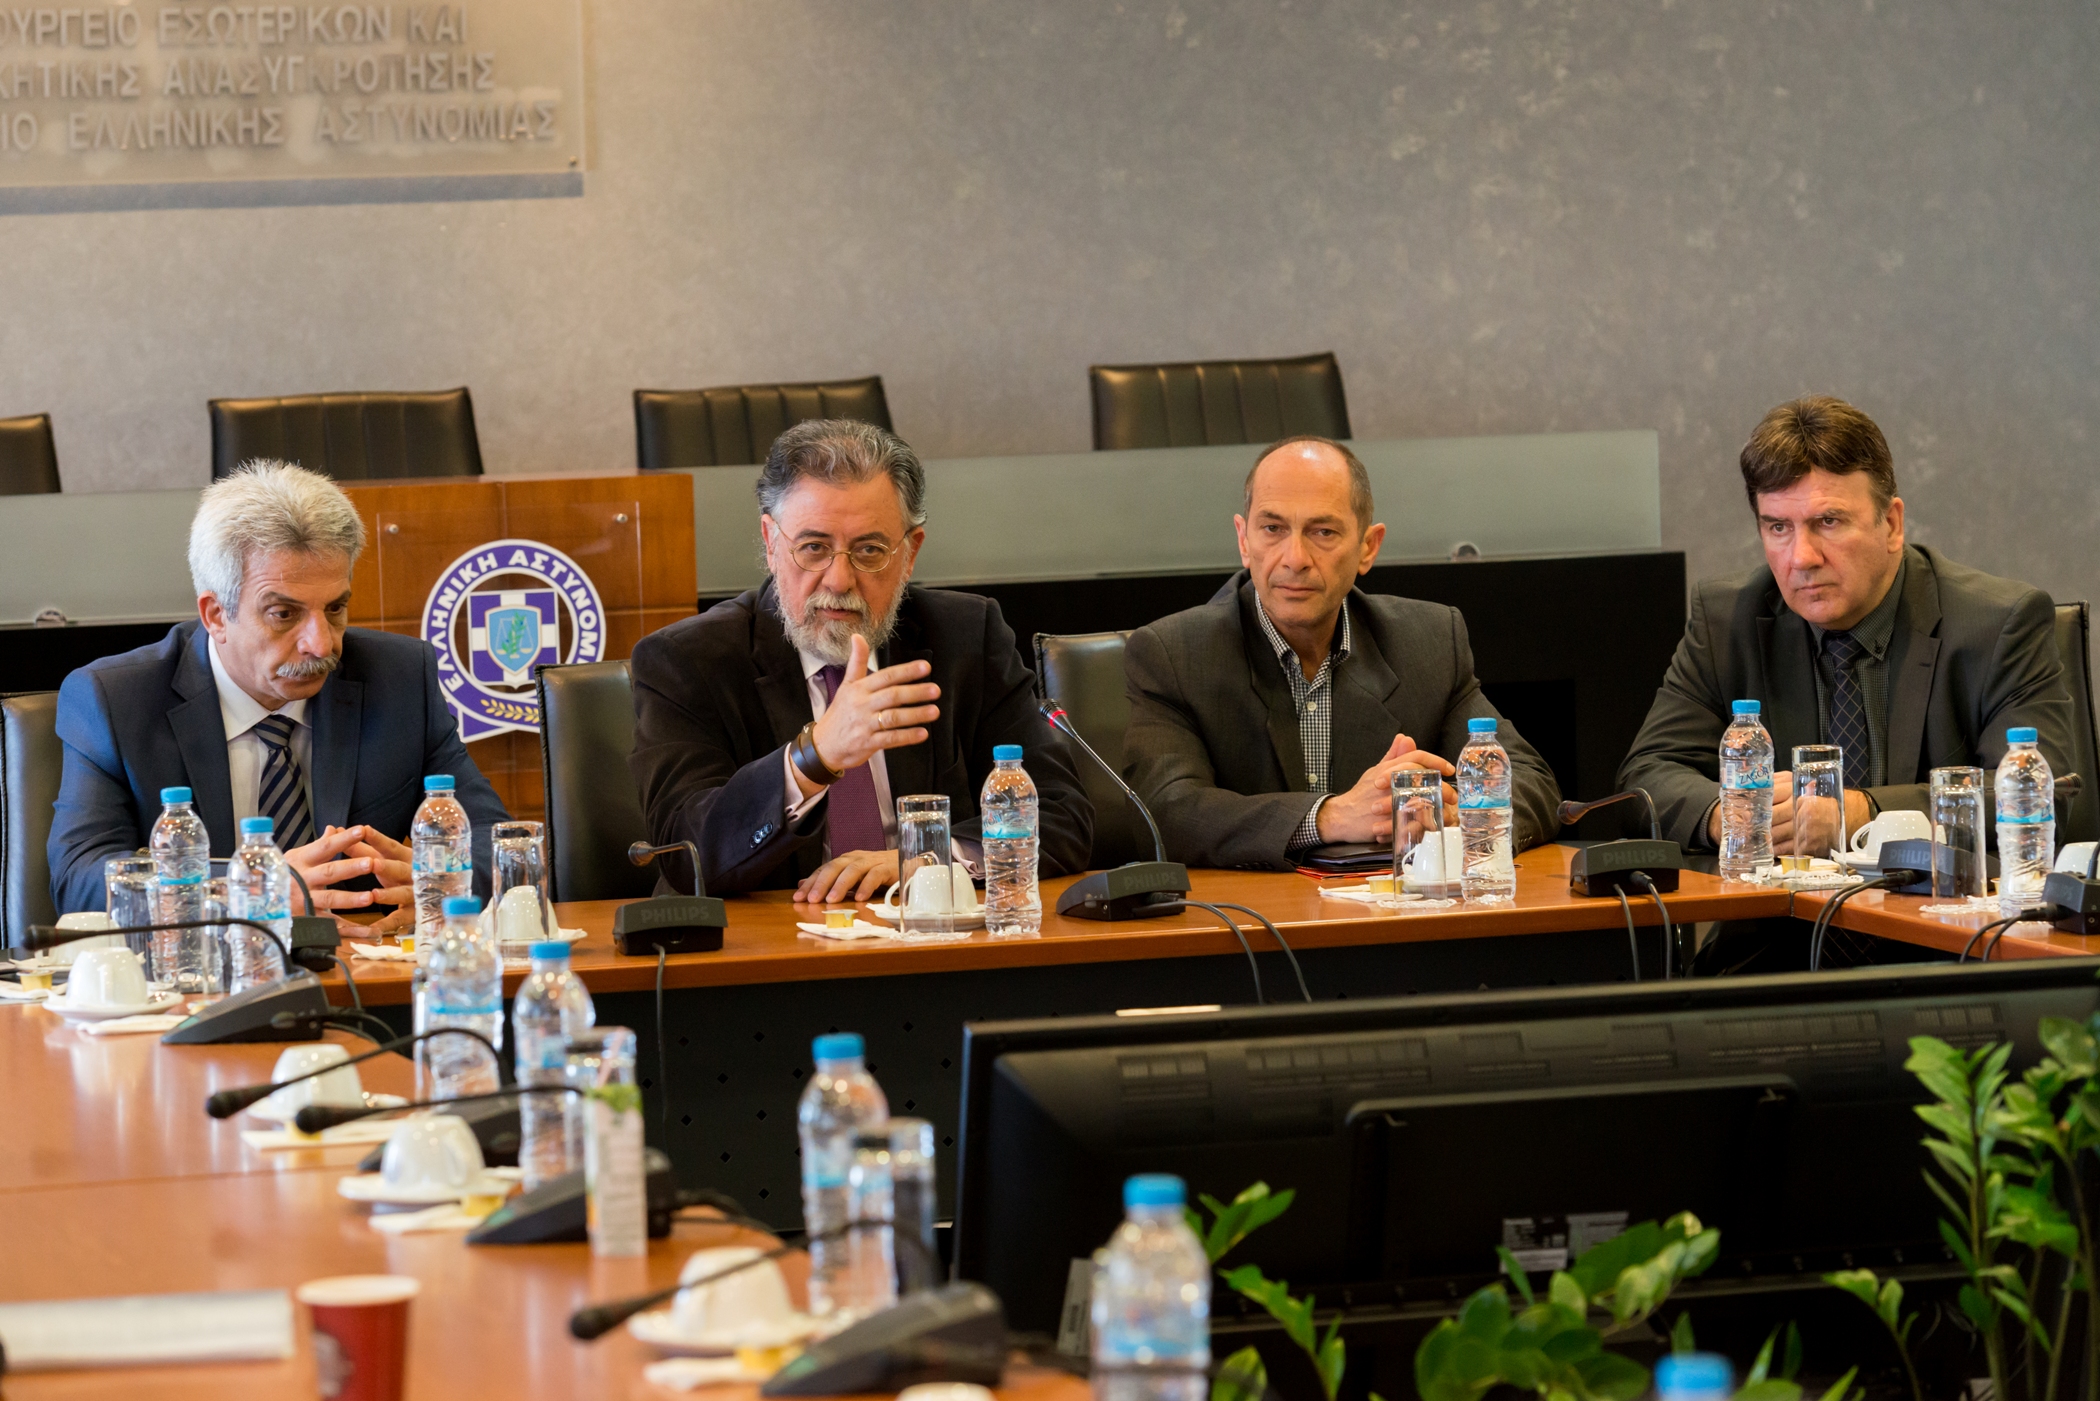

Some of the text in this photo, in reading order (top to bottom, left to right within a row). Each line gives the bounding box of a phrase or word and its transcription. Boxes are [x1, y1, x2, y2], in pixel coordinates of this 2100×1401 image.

[158, 6, 392, 44] ΕΣΩΤΕΡΙΚΩΝ
[408, 5, 468, 43] ΚΑΙ
[68, 107, 285, 150] ΕΛΛΗΝΙΚΗΣ
[316, 102, 558, 143] ΑΣΤΥΝΟΜΙΑΣ
[431, 552, 498, 692] ΕΛΛΗΝΙΚΗ
[1602, 849, 1668, 867] PHILIPS
[1123, 871, 1178, 890] PHILIPS
[640, 906, 709, 924] PHILIPS
